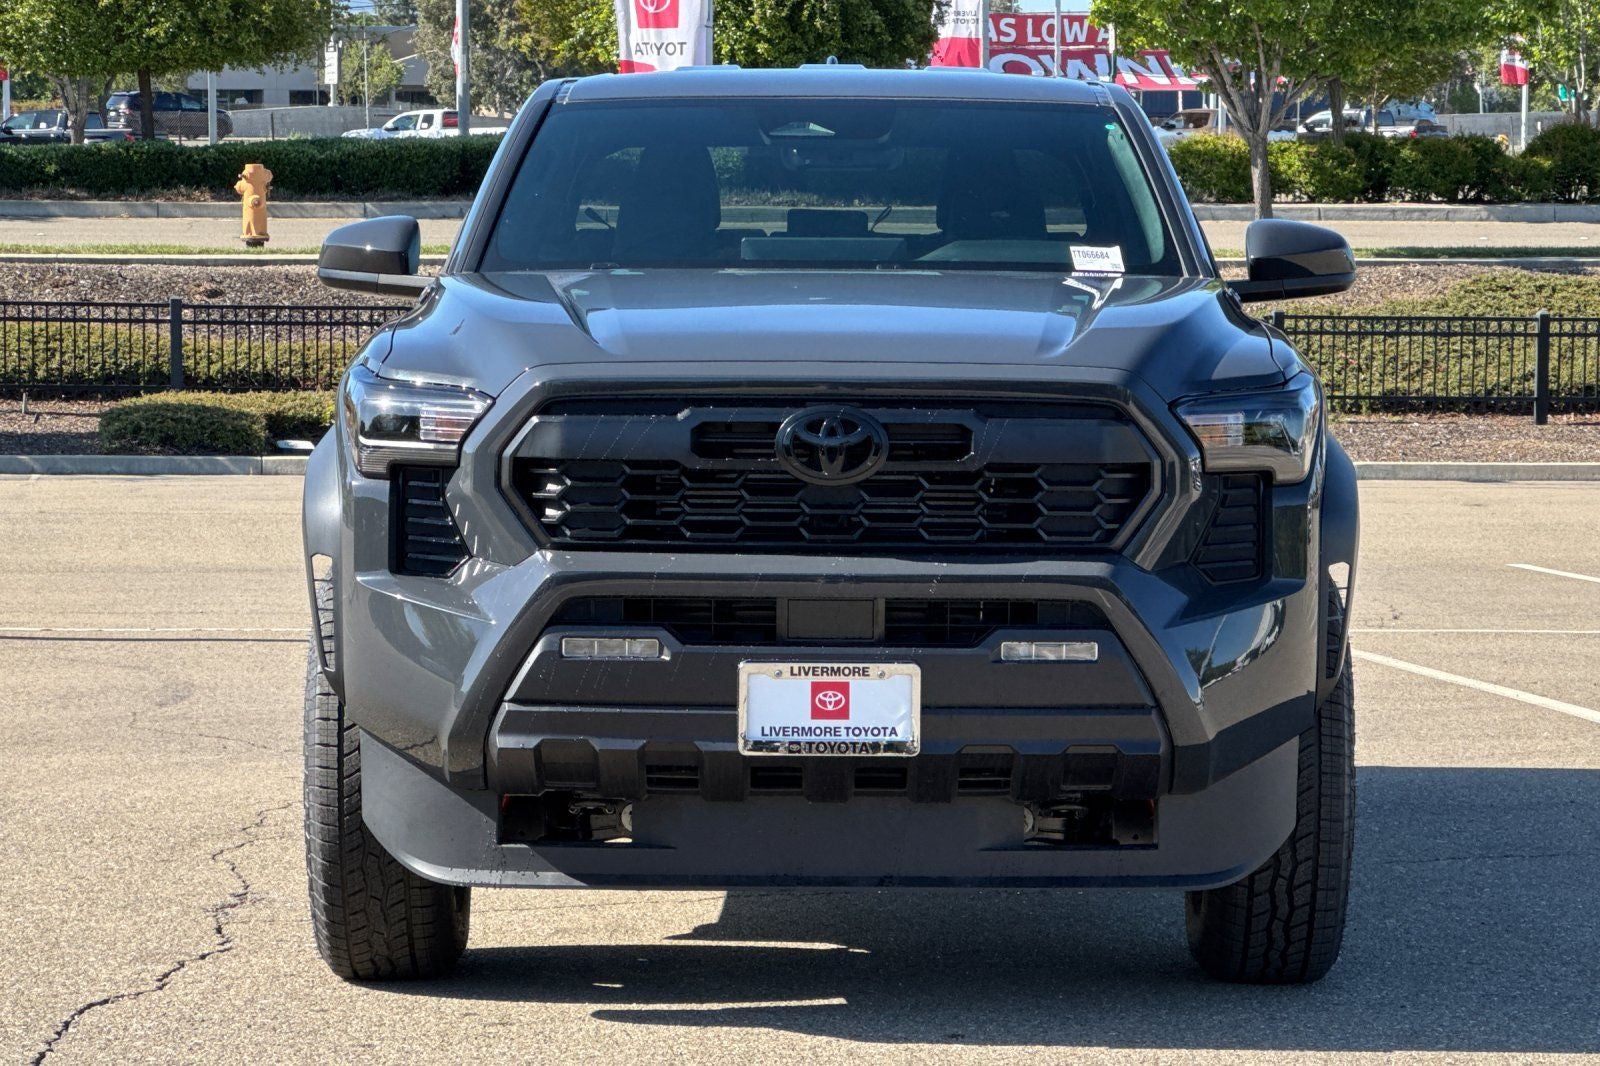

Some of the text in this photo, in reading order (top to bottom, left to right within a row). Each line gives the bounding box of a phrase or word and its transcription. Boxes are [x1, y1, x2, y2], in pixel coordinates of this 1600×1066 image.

[1027, 18, 1089, 43] LOW
[790, 666, 870, 677] LIVERMORE
[761, 726, 898, 737] LIVERMORE TOYOTA
[806, 741, 871, 754] TOYOTA
